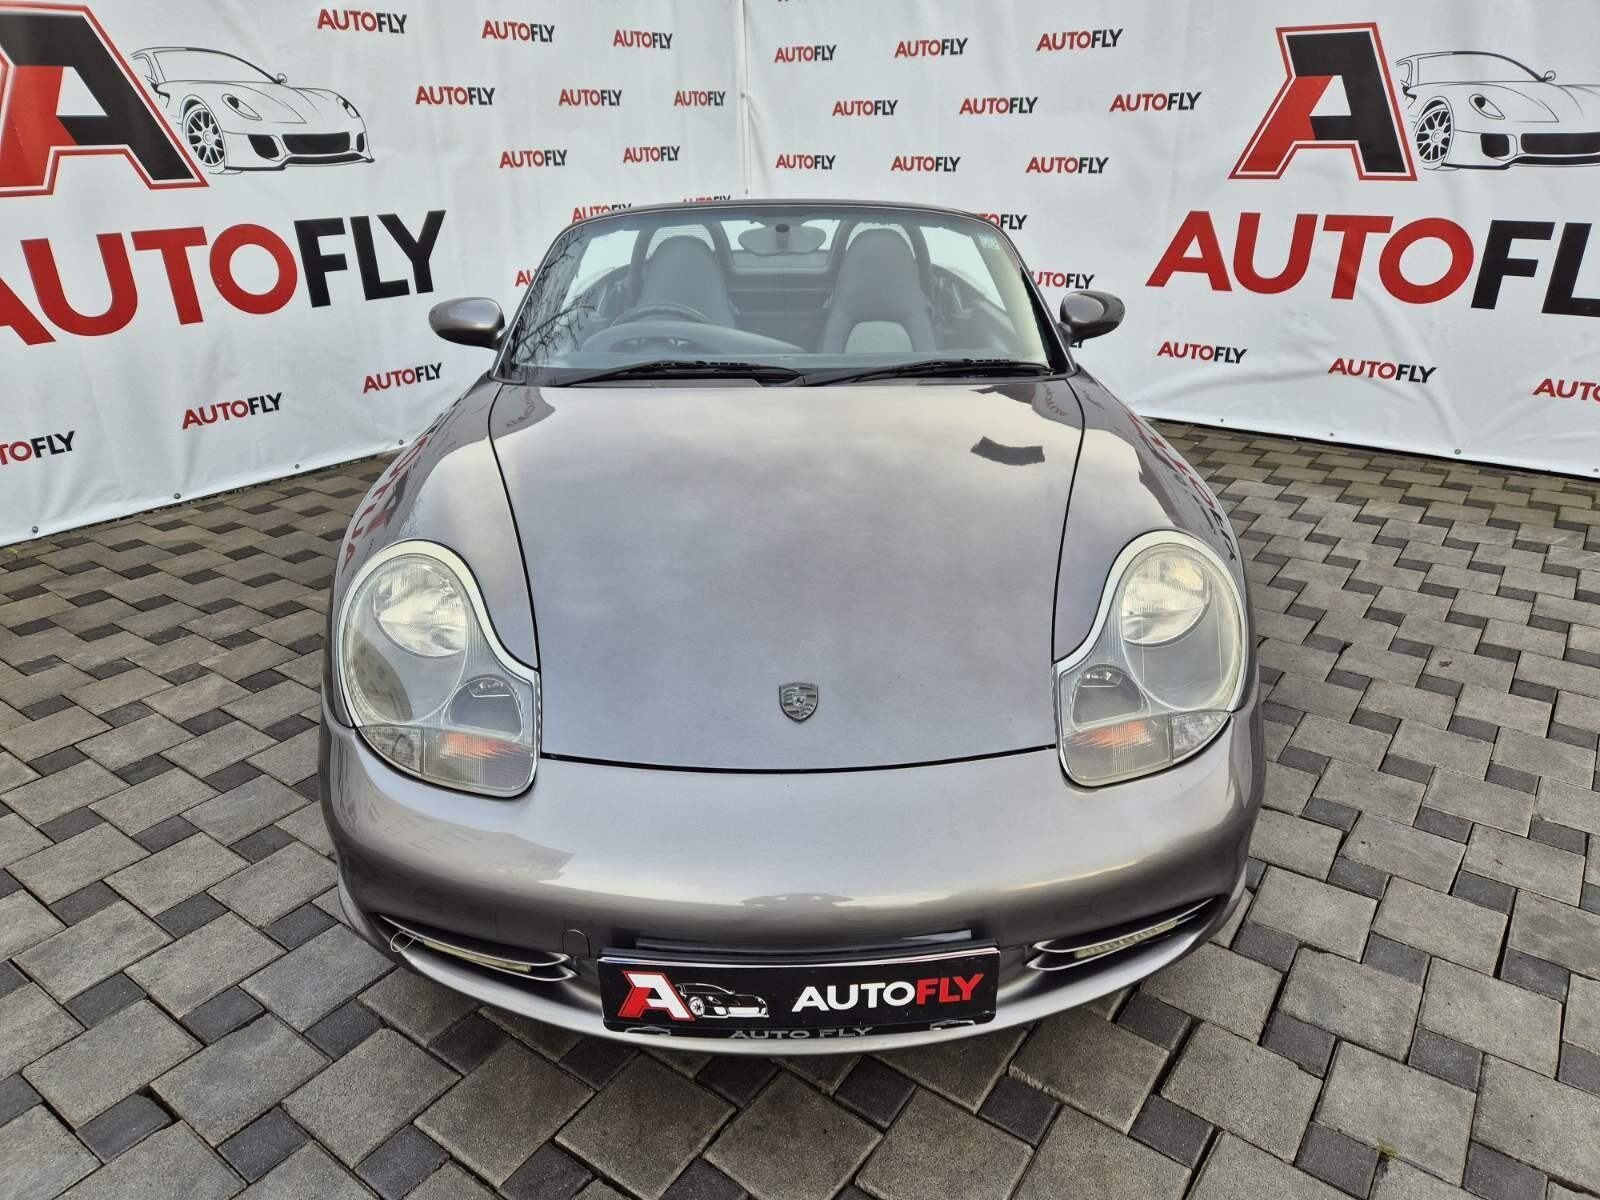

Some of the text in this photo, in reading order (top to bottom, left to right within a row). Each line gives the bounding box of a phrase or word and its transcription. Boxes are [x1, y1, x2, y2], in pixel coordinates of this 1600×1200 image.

[317, 8, 408, 35] AUTOFLY
[482, 20, 555, 43] AUTOFLY
[612, 29, 673, 50] AUTOFLY
[895, 38, 969, 58] AUTOFLY
[1036, 28, 1124, 52] AUTOFLY
[774, 44, 837, 63] AUTOFLY
[415, 85, 496, 106] AUTOFLY
[558, 88, 623, 107] AUTOFLY
[673, 90, 726, 107] AUTOFLY
[1109, 91, 1202, 113] AUTOFLY
[832, 99, 899, 117] AUTOFLY
[960, 96, 1039, 116] AUTOFLY
[499, 149, 568, 169] AUTOFLY
[622, 145, 681, 164] AUTOFLY
[775, 154, 836, 171] AUTOFLY
[890, 155, 961, 173] AUTOFLY
[1025, 156, 1110, 175] AUTOFLY
[1145, 210, 1600, 318] AUTOFL
[1029, 271, 1095, 290] UTOFLY
[1156, 341, 1248, 365] AUTOFLY
[363, 362, 442, 394] AUTOFLY
[1327, 357, 1437, 384] AUTOFLY
[182, 392, 282, 430] AUTOFLY
[791, 973, 985, 1013] AUTOFLY
[729, 1026, 874, 1040] AUTO FLY
